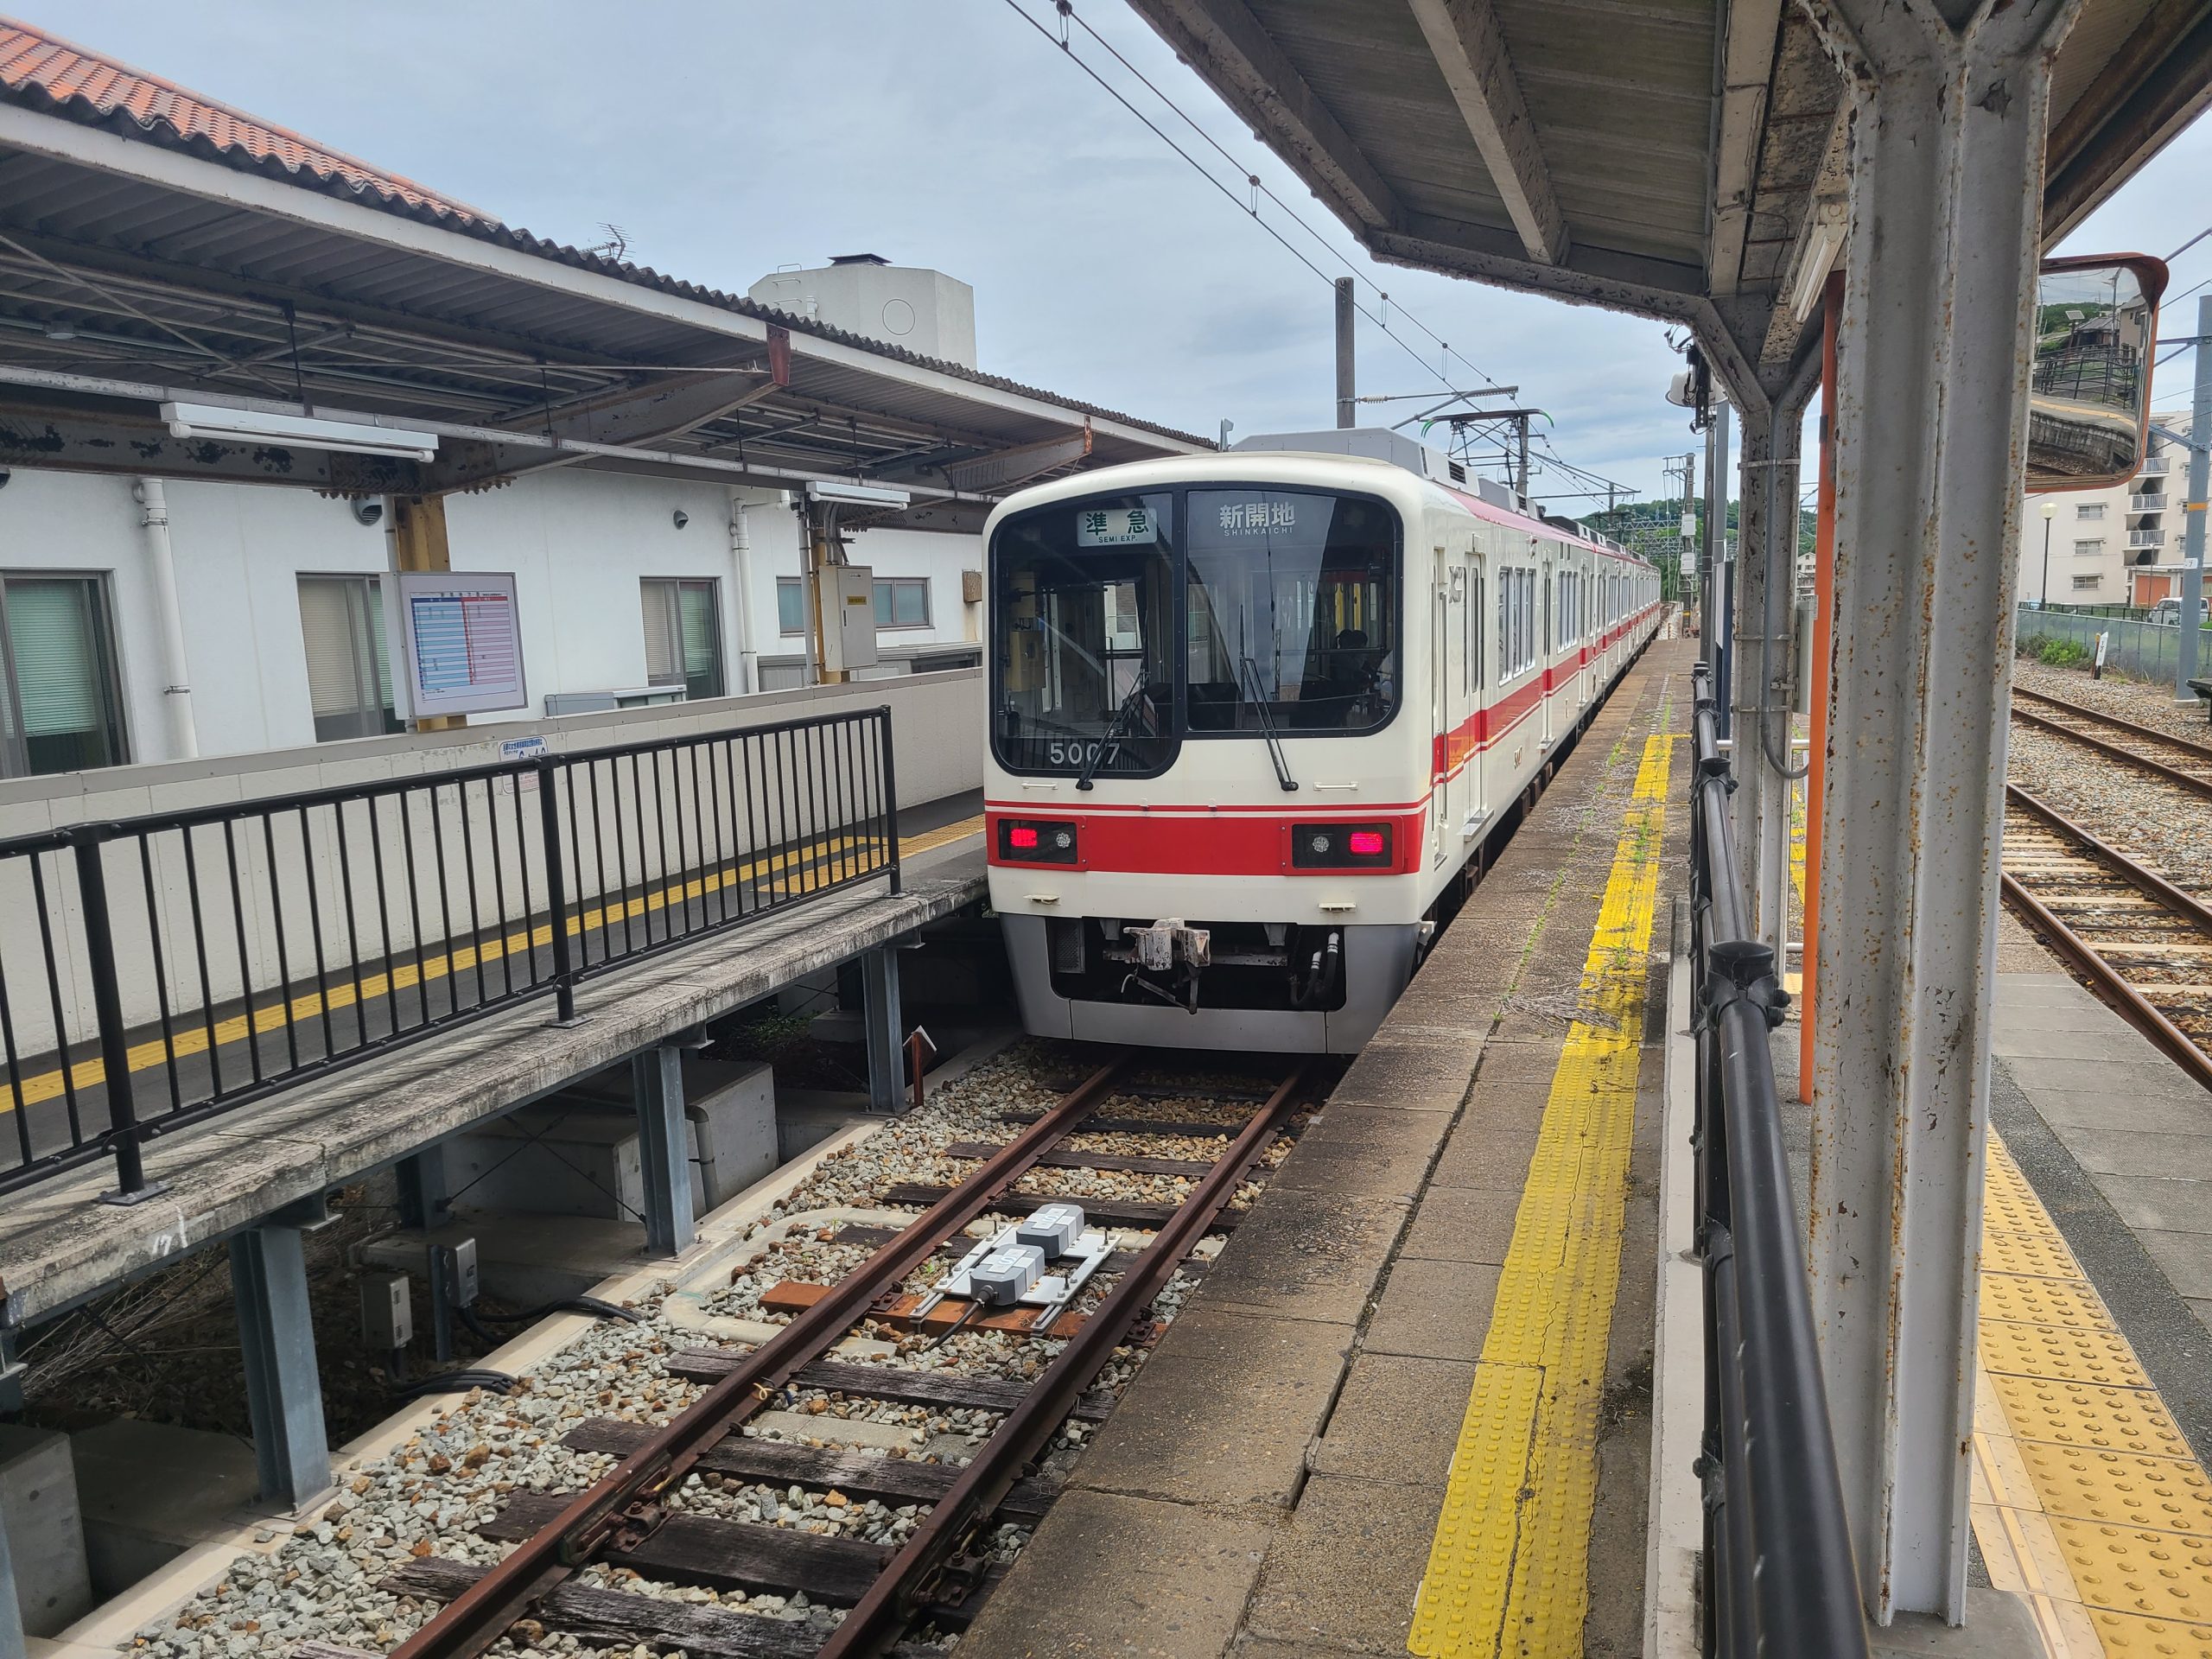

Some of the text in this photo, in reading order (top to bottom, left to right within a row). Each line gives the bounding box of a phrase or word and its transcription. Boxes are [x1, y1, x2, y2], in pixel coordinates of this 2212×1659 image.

[1085, 510, 1149, 536] 準急
[1219, 501, 1296, 529] 新開地
[1224, 526, 1293, 537] SHINKAICHI
[1050, 742, 1120, 765] 5007
